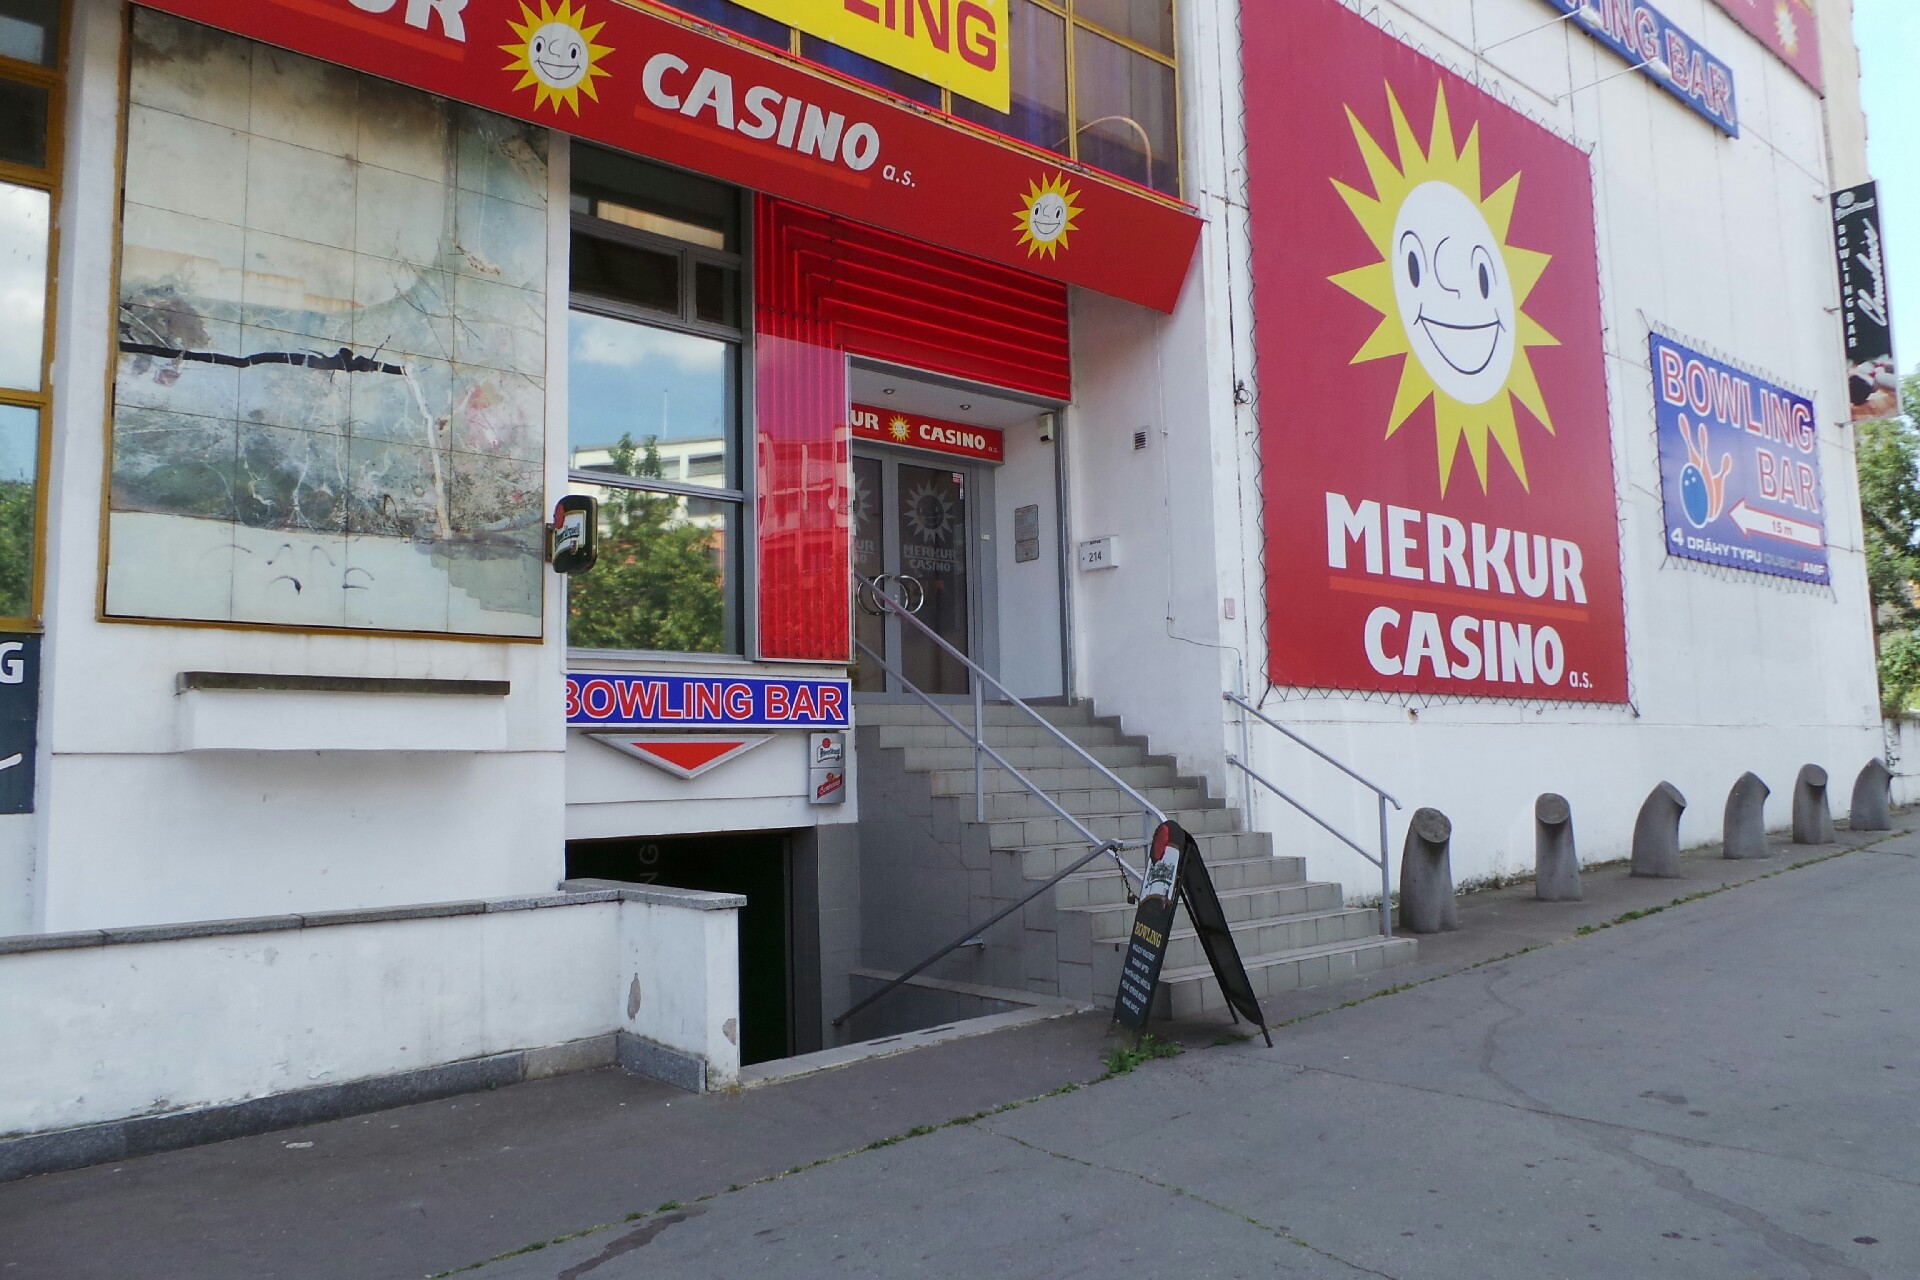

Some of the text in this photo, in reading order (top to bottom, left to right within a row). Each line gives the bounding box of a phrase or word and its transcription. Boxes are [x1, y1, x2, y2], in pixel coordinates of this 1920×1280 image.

[843, 0, 997, 72] ING
[1666, 28, 1735, 127] BAR
[642, 53, 880, 171] CASINO
[883, 163, 916, 188] a.s.
[1659, 345, 1814, 454] BOWLING
[919, 424, 986, 450] CASINO
[1757, 448, 1819, 514] BAR
[1671, 527, 1684, 546] 4
[1731, 545, 1762, 564] TYPU
[1772, 520, 1793, 536] 15 m
[903, 544, 957, 560] MERKUR
[909, 560, 950, 572] CASINO
[1089, 551, 1102, 562] 214
[1325, 491, 1588, 604] MERKUR
[1363, 606, 1594, 689] CASINO a.s.
[764, 684, 844, 721] BAR
[1134, 920, 1162, 948] BOWLING
